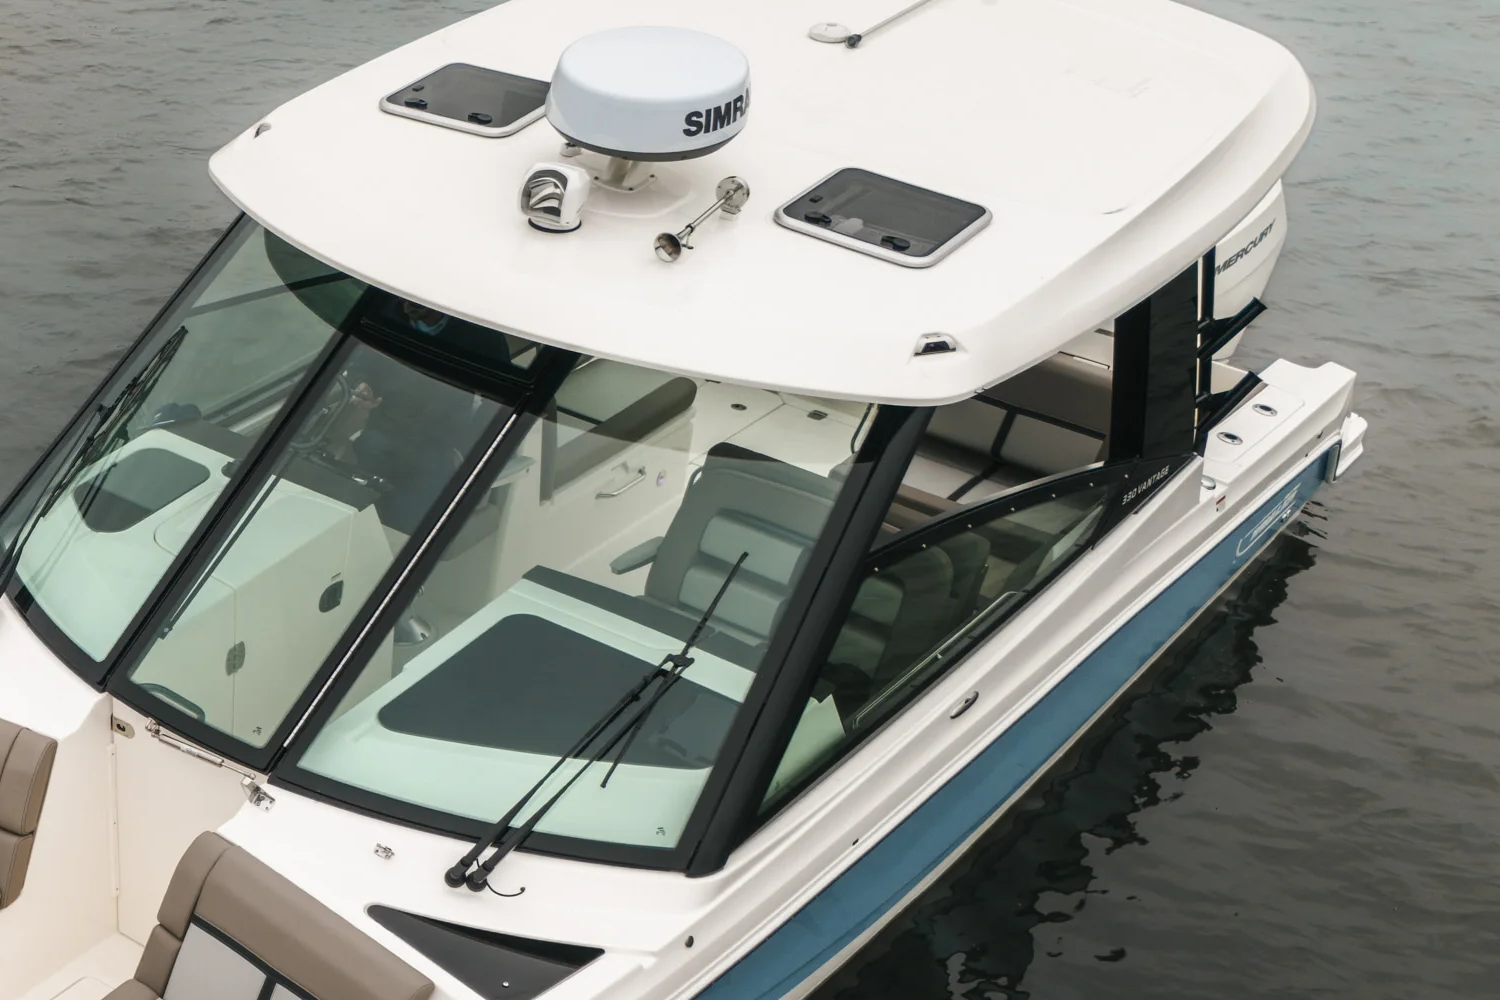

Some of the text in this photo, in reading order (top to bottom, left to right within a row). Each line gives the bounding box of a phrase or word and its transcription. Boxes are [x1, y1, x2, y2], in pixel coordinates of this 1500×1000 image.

[1214, 217, 1277, 275] MERCURY
[1121, 464, 1170, 506] 330 VANTAGE
